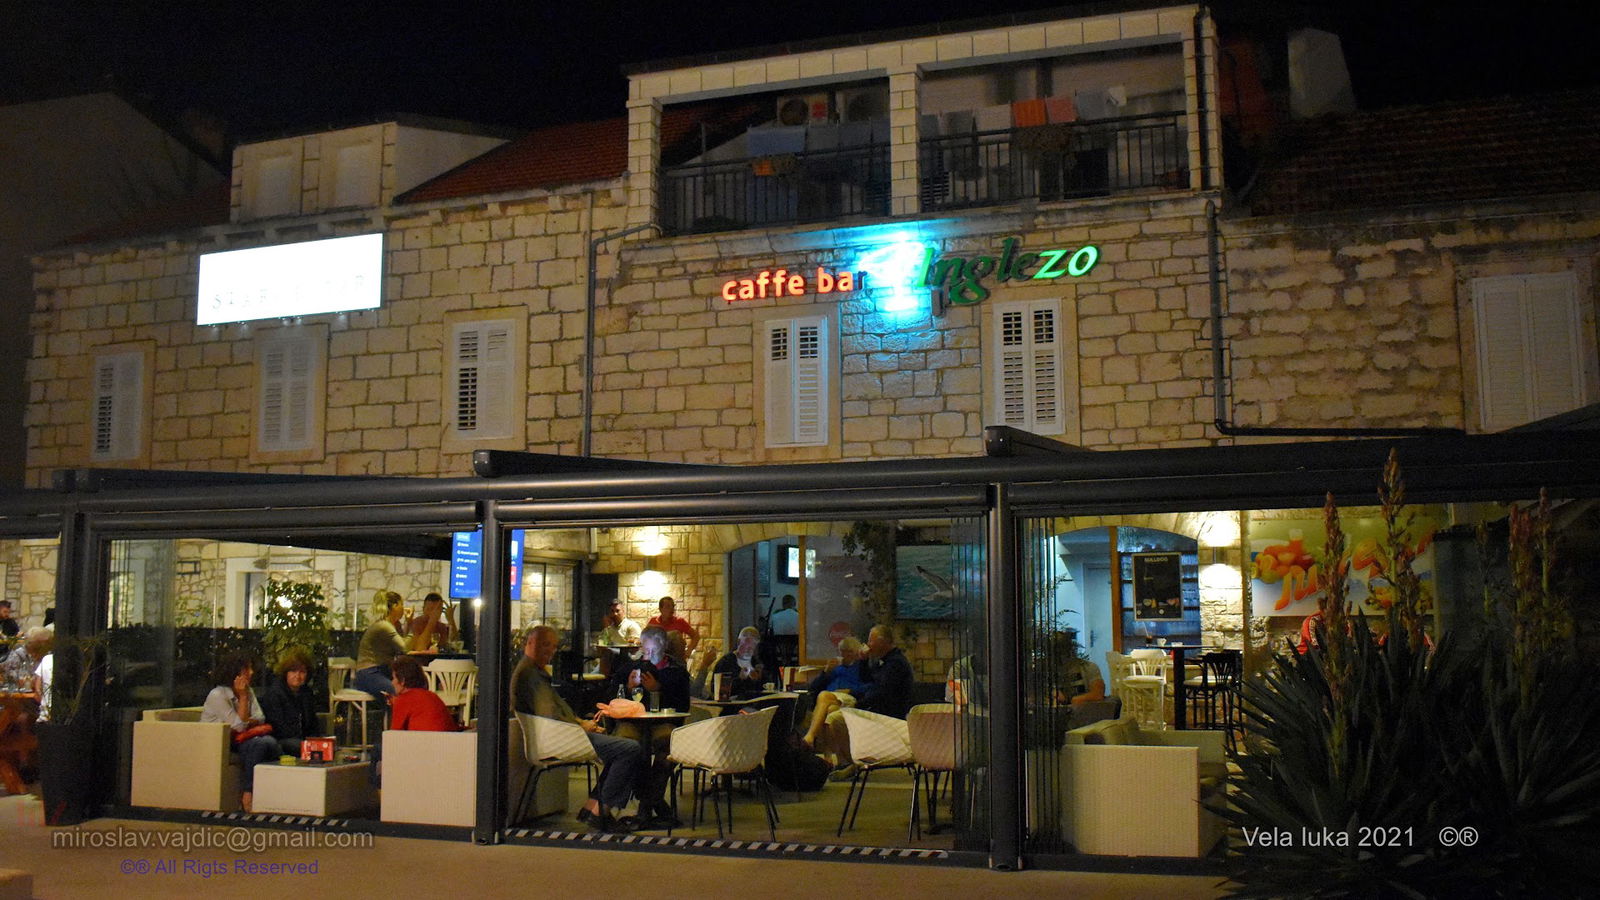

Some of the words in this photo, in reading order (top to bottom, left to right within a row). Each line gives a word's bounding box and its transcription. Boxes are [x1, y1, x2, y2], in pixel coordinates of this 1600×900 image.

[722, 268, 804, 301] caffe
[817, 267, 867, 293] bar
[916, 237, 1100, 305] Inglezo
